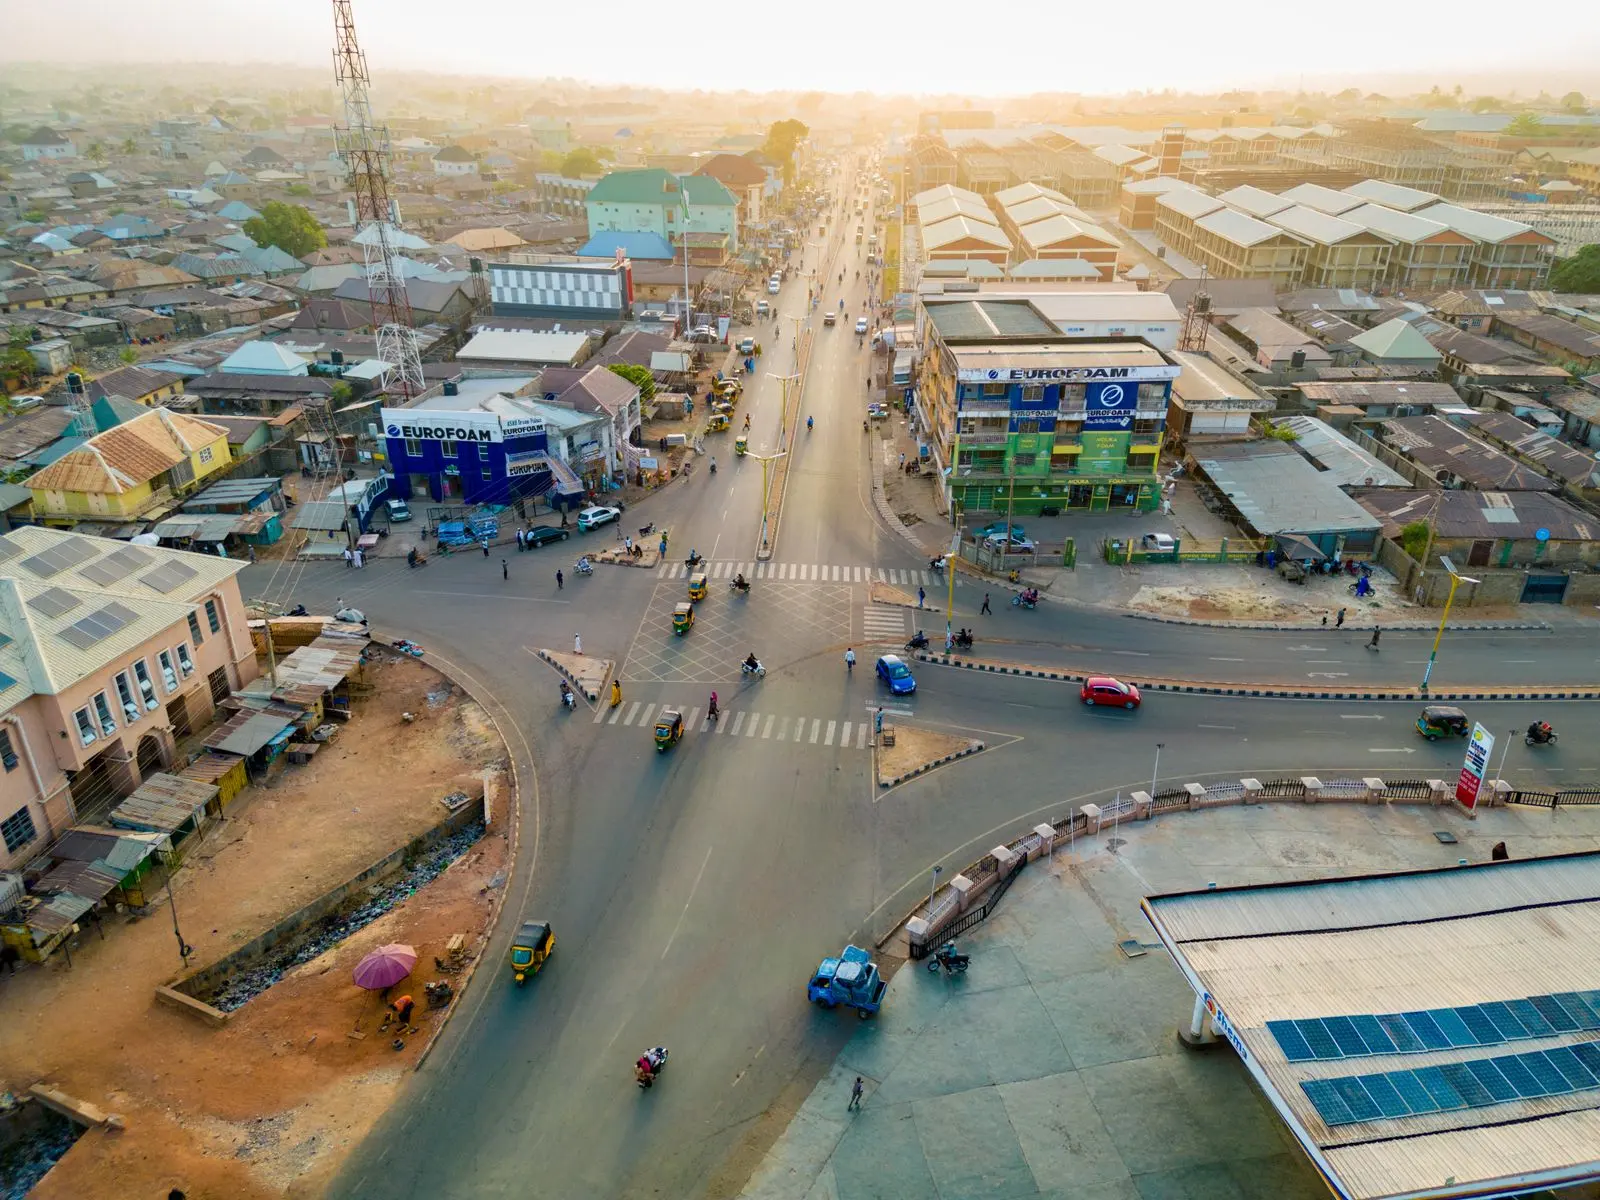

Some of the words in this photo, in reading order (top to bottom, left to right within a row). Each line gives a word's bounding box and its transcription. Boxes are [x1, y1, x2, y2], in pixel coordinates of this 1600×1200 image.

[1010, 368, 1129, 379] EUROFOAM
[401, 425, 492, 441] EUROFOAM
[503, 424, 543, 435] EUROFOAM
